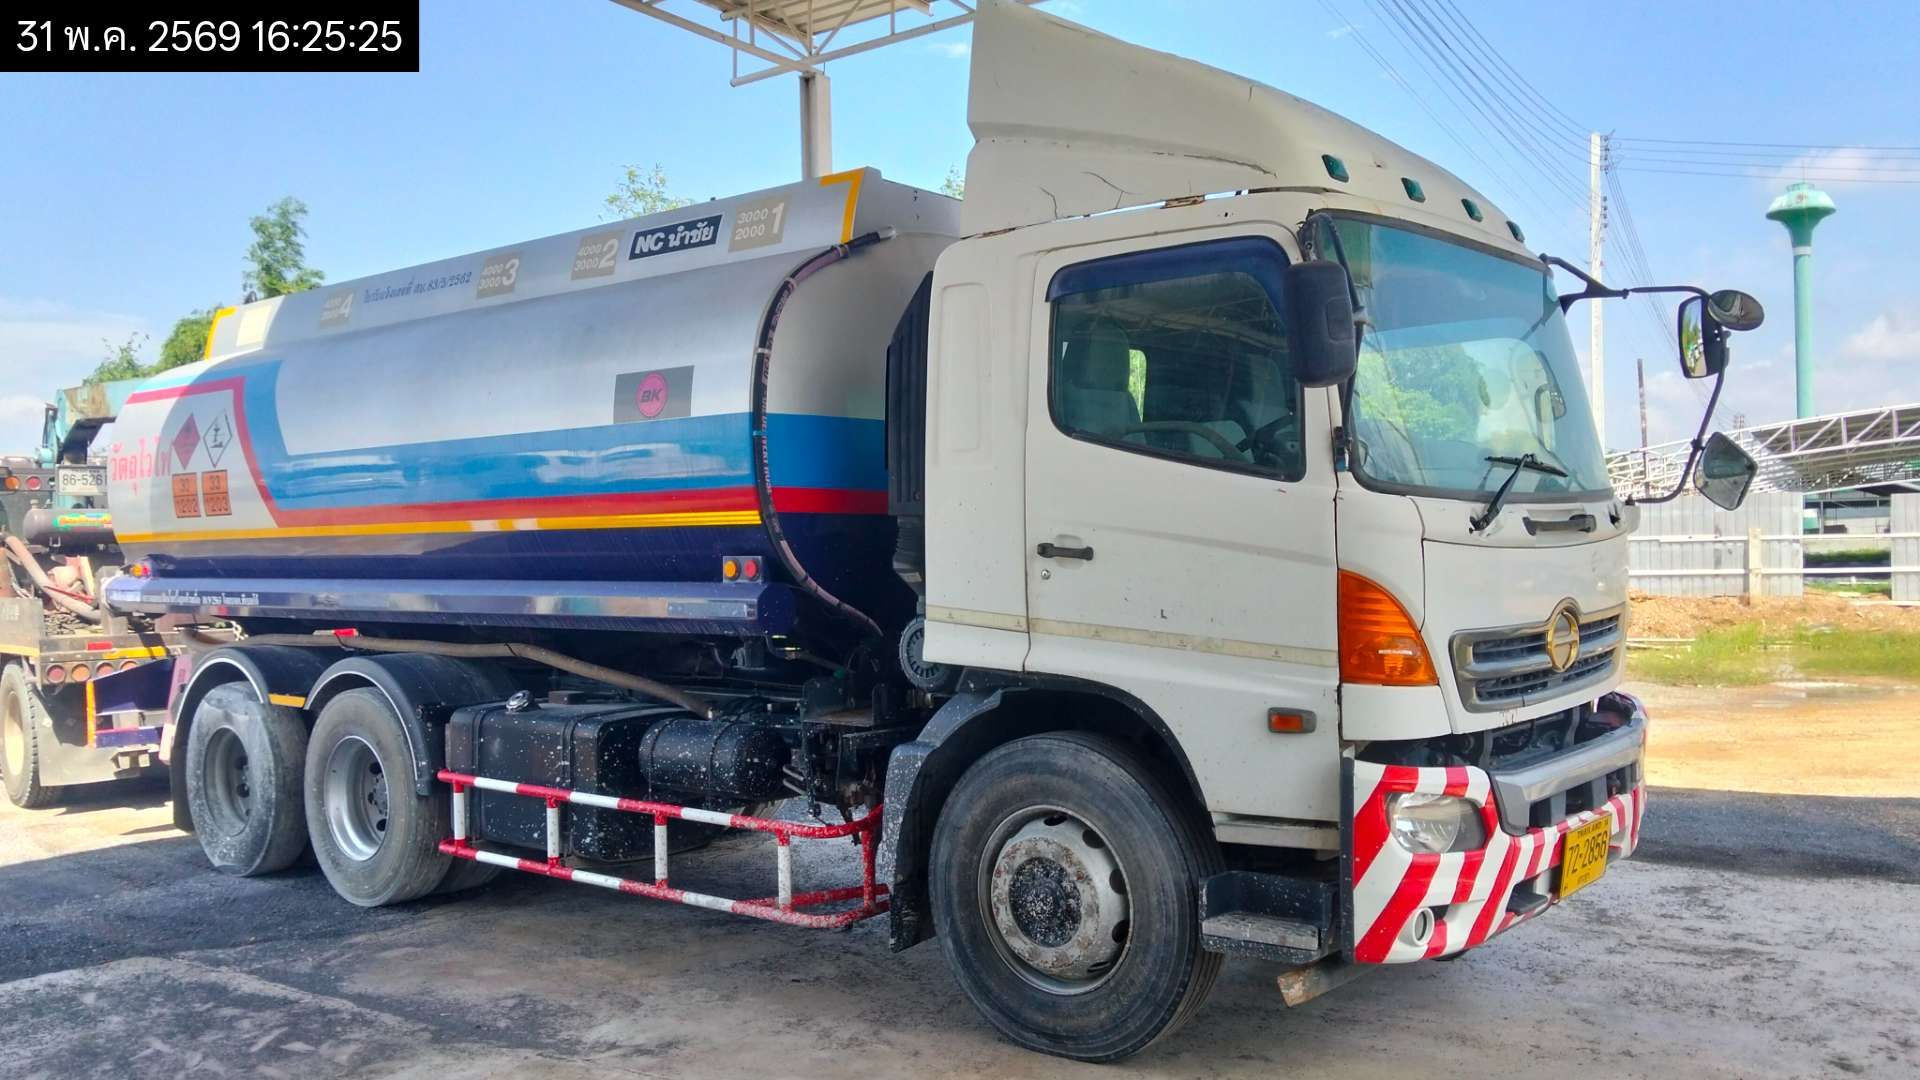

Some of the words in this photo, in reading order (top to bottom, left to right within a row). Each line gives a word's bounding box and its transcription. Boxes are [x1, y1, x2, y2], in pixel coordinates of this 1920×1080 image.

[737, 208, 769, 224] 3000
[771, 202, 784, 235] 1
[634, 232, 665, 255] NC
[668, 221, 714, 248] นำชัย
[734, 224, 765, 241] 2000
[598, 238, 618, 270] 2
[502, 258, 520, 286] 3
[339, 293, 354, 319] 4
[640, 387, 662, 403] BK
